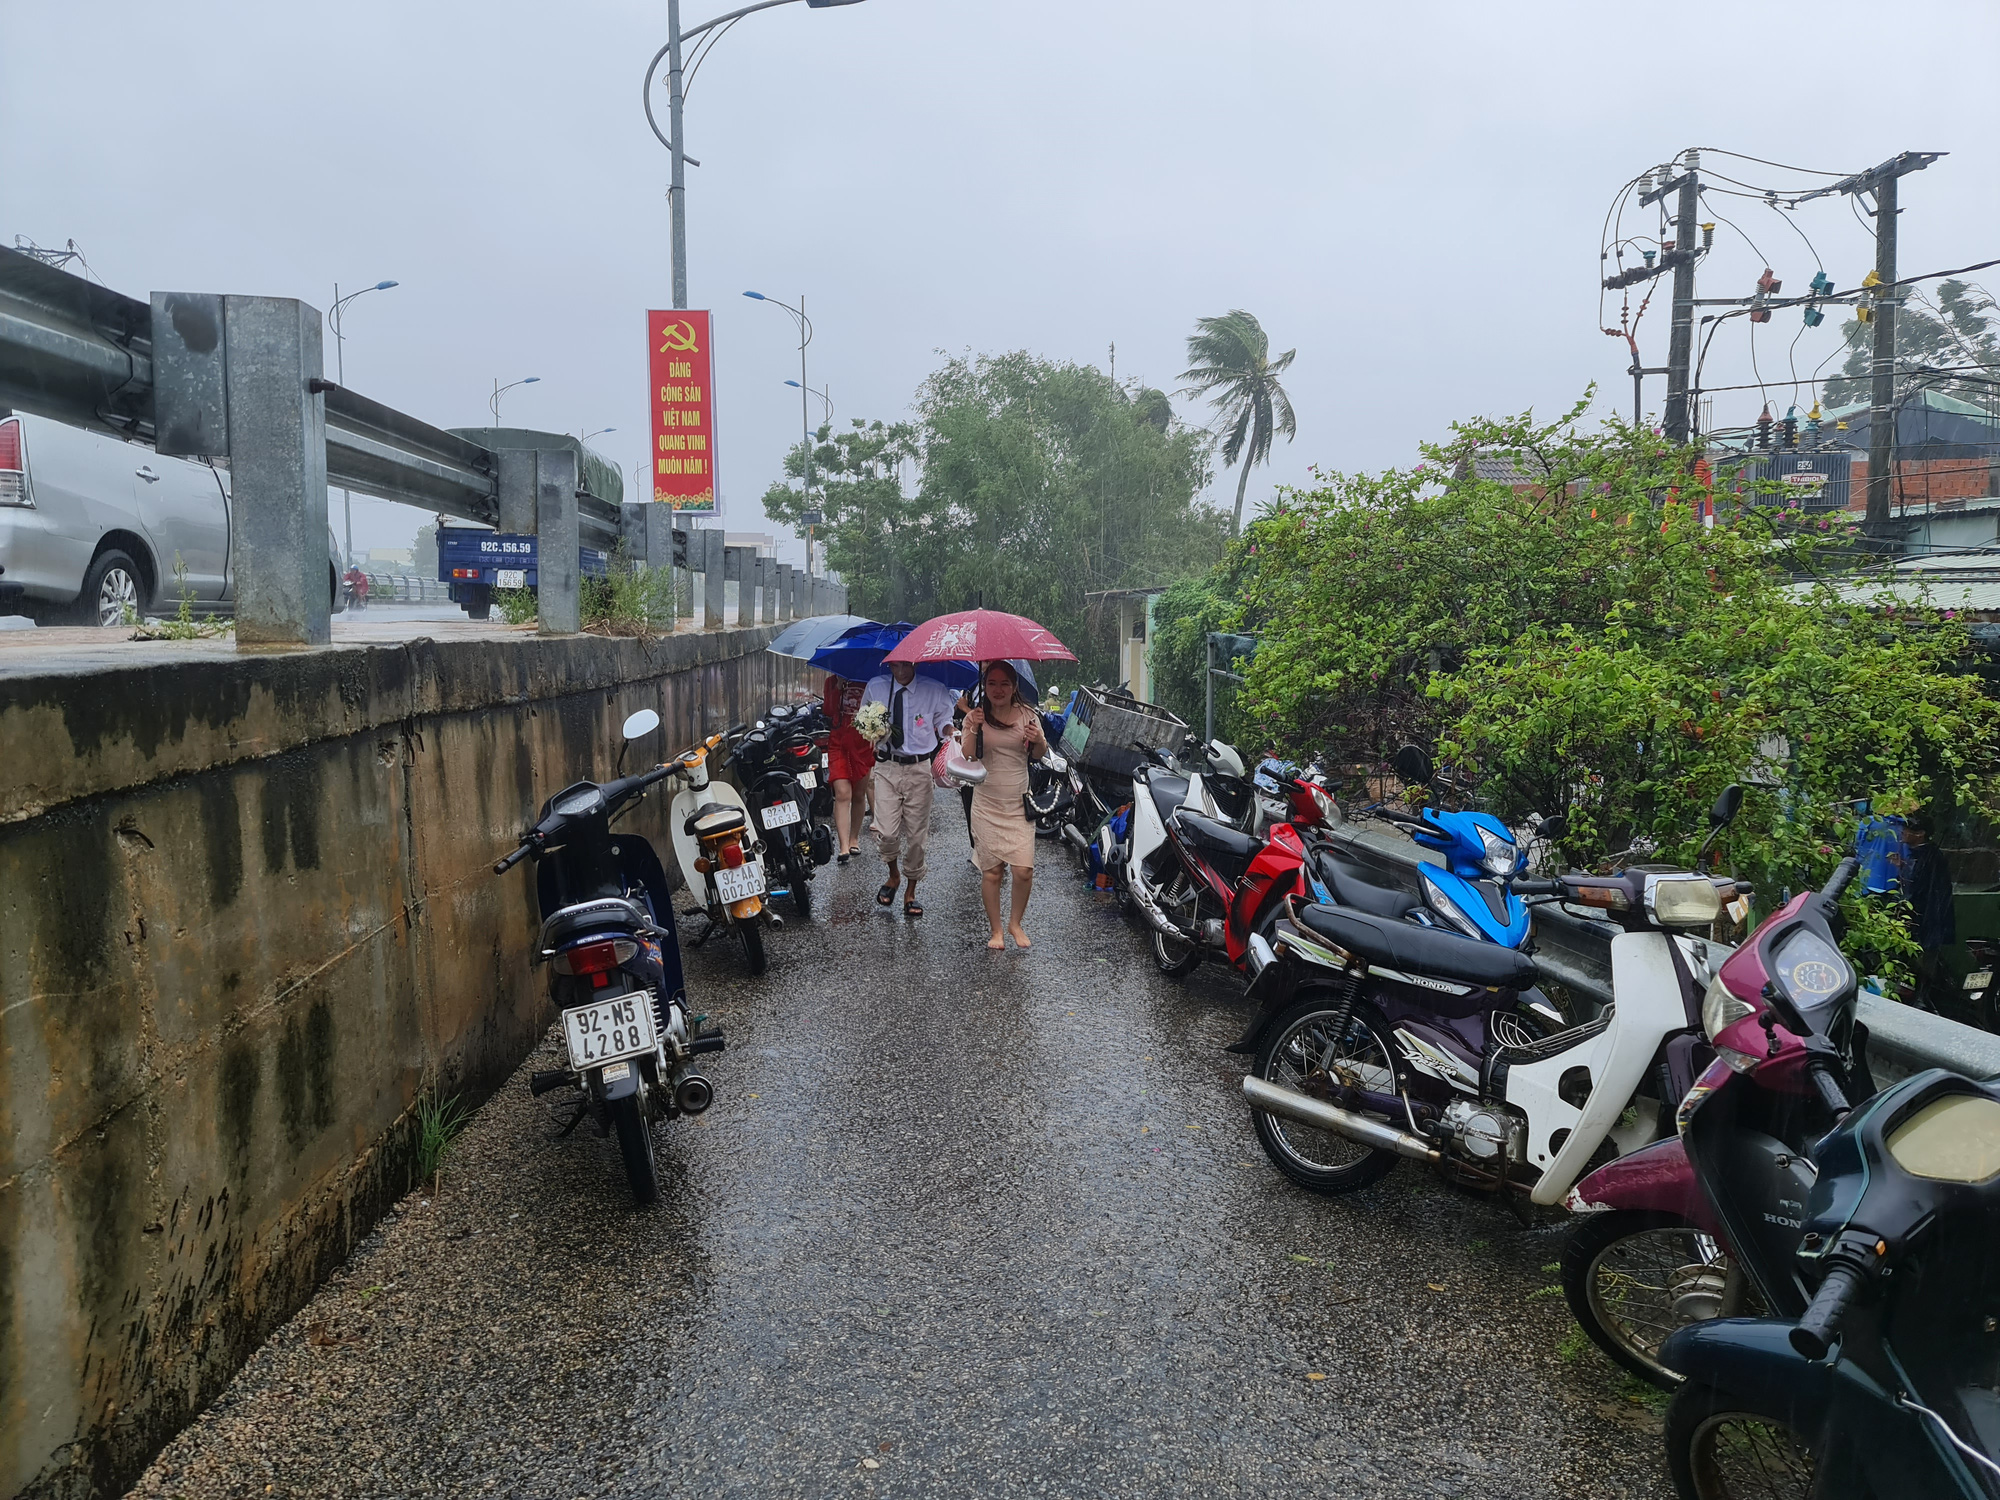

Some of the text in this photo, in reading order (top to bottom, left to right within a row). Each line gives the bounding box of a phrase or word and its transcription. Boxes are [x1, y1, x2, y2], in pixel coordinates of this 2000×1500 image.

[669, 356, 692, 378] ĐẢNG
[661, 381, 701, 405] CỘNG SẢN
[663, 407, 700, 429] VIỆT NAM
[658, 434, 706, 452] QUANG VINH
[658, 455, 682, 474] MUÔN
[683, 455, 703, 474] NĂM
[480, 541, 531, 554] 92C.156.59
[498, 579, 522, 587] 156.59
[503, 570, 518, 579] 92C
[766, 812, 798, 828] 016.35
[767, 804, 792, 818] 92-V1
[722, 866, 754, 885] 92-AA
[722, 879, 762, 901] 002.03
[1413, 978, 1453, 993] HONDA
[576, 1001, 635, 1034] 92-N5
[1402, 1050, 1457, 1077] DREAM
[1763, 1212, 1802, 1229] HON
